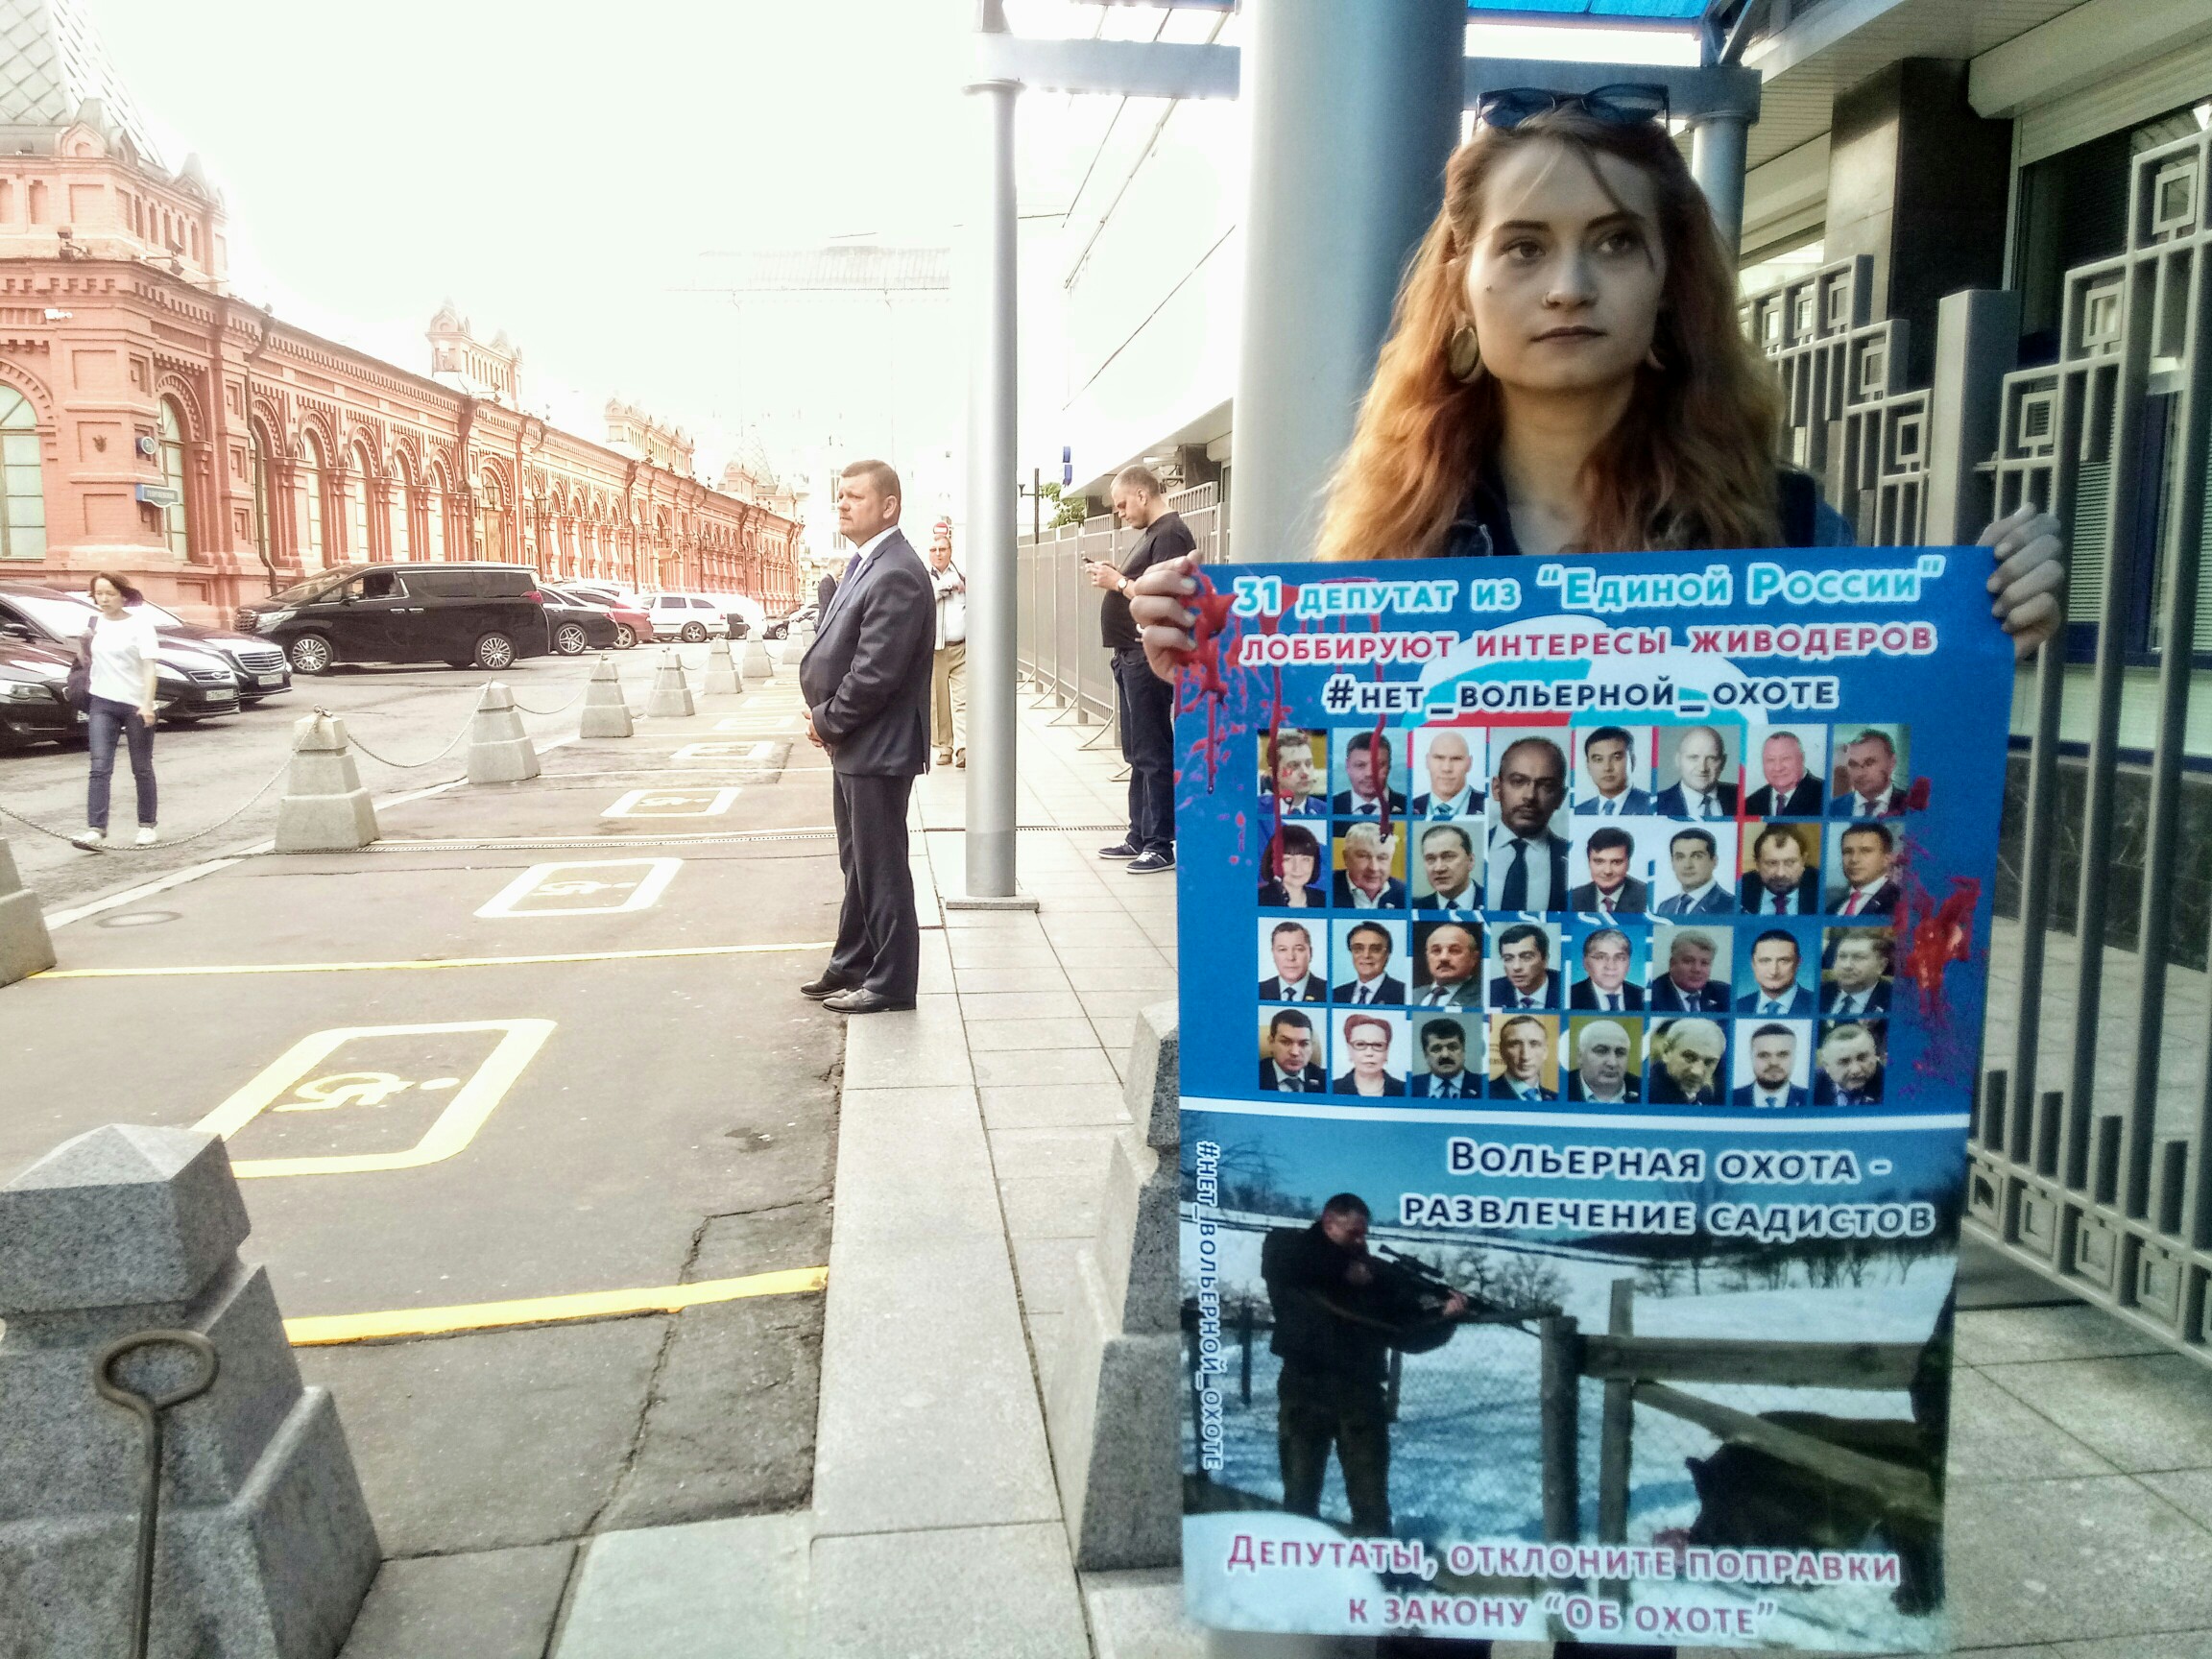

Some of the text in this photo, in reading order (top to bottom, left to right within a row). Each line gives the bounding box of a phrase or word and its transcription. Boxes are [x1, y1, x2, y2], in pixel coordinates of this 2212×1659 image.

[1236, 580, 1280, 613] 31
[1300, 584, 1454, 616] ДЕПУТАТ
[1474, 585, 1519, 609] ИЗ
[1243, 627, 1932, 662] ЛОББИРУЮТ ИНТЕРЕСЫ ЖИВОДЕРОВ
[1452, 1141, 1700, 1177] ВОЛЬЕРНАЯ
[1720, 1154, 1857, 1179] ОХОТА
[1405, 1198, 1932, 1238] РАЗВЛЕЧЕНИЕ САДИСТОВ
[1227, 1535, 1896, 1582] ДЕПУТАТЫ, ОТКЛОНИТЕ ПОПРАВКИ
[1349, 1599, 1367, 1624] К
[1384, 1599, 1528, 1627] ЗАКОНУ
